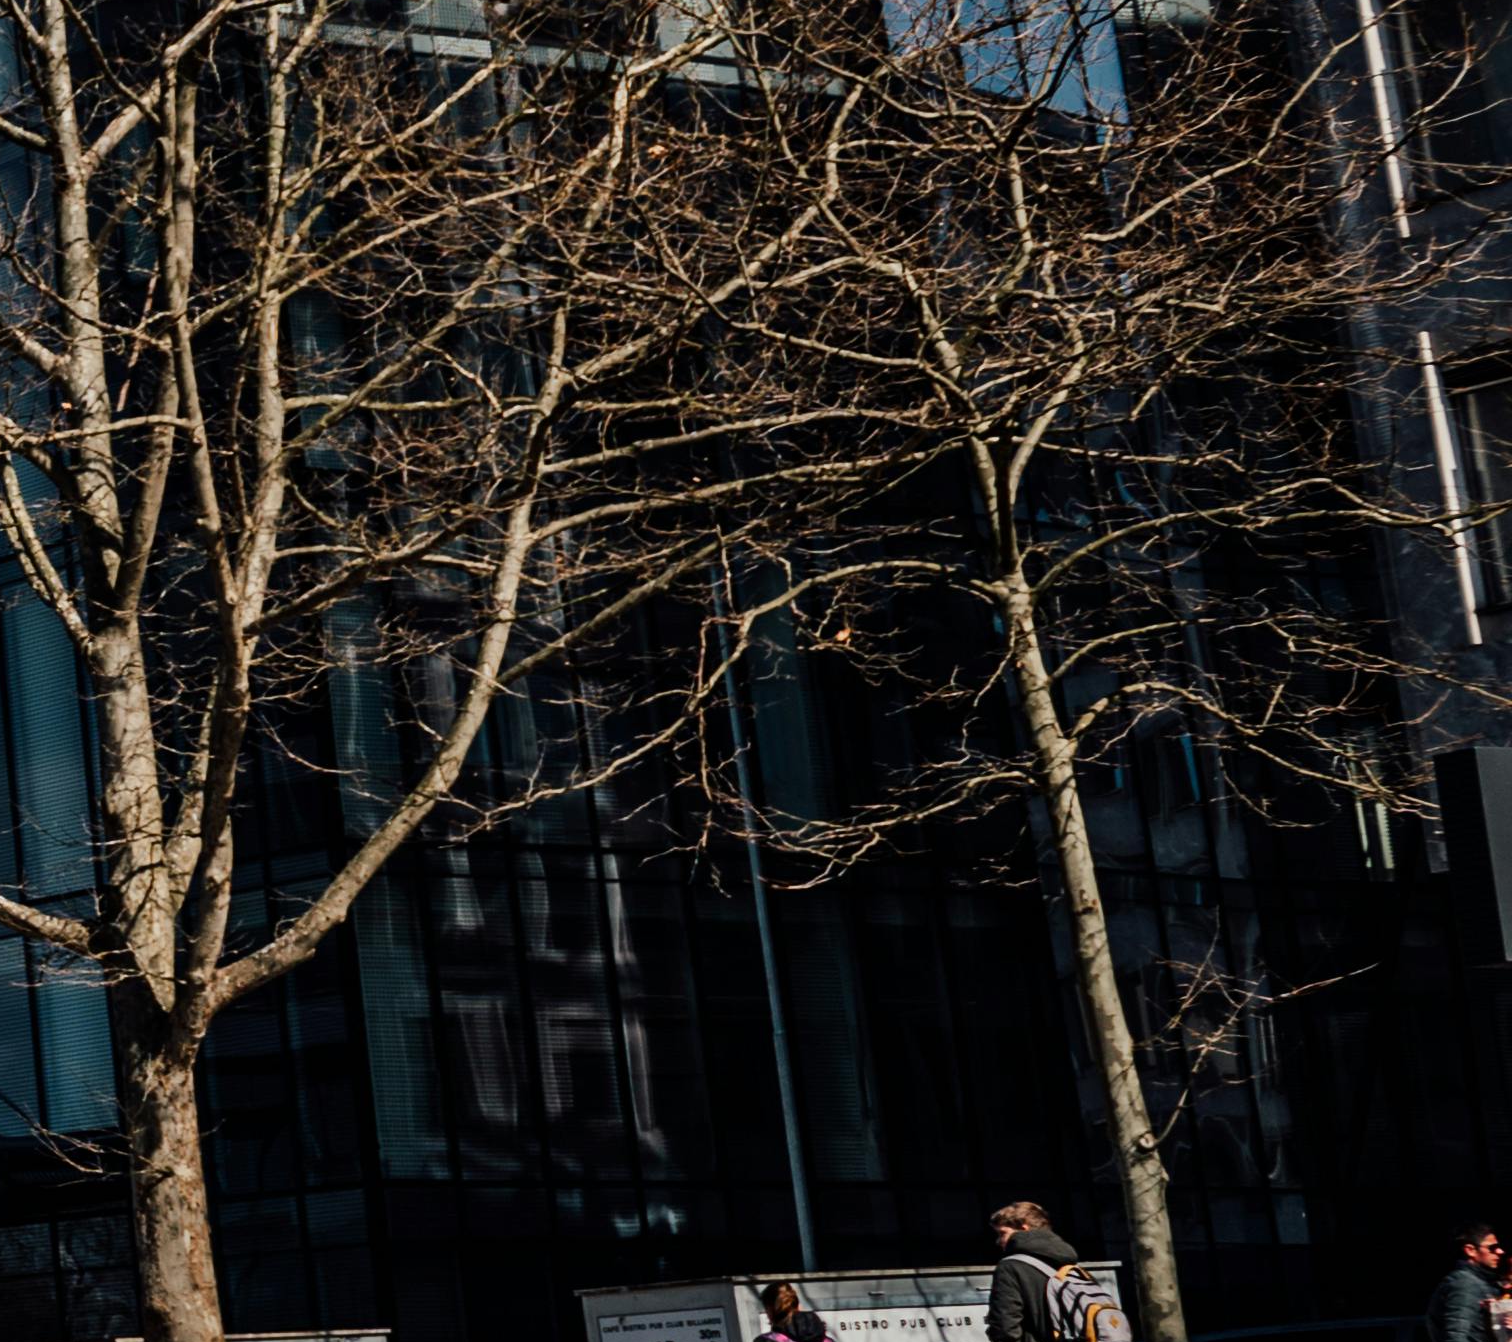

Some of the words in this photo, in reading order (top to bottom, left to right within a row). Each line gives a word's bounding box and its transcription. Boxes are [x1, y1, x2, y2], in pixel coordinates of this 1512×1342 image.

[840, 1319, 889, 1331] BISTRO
[900, 1318, 927, 1329] PUB
[938, 1316, 972, 1327] CLUB
